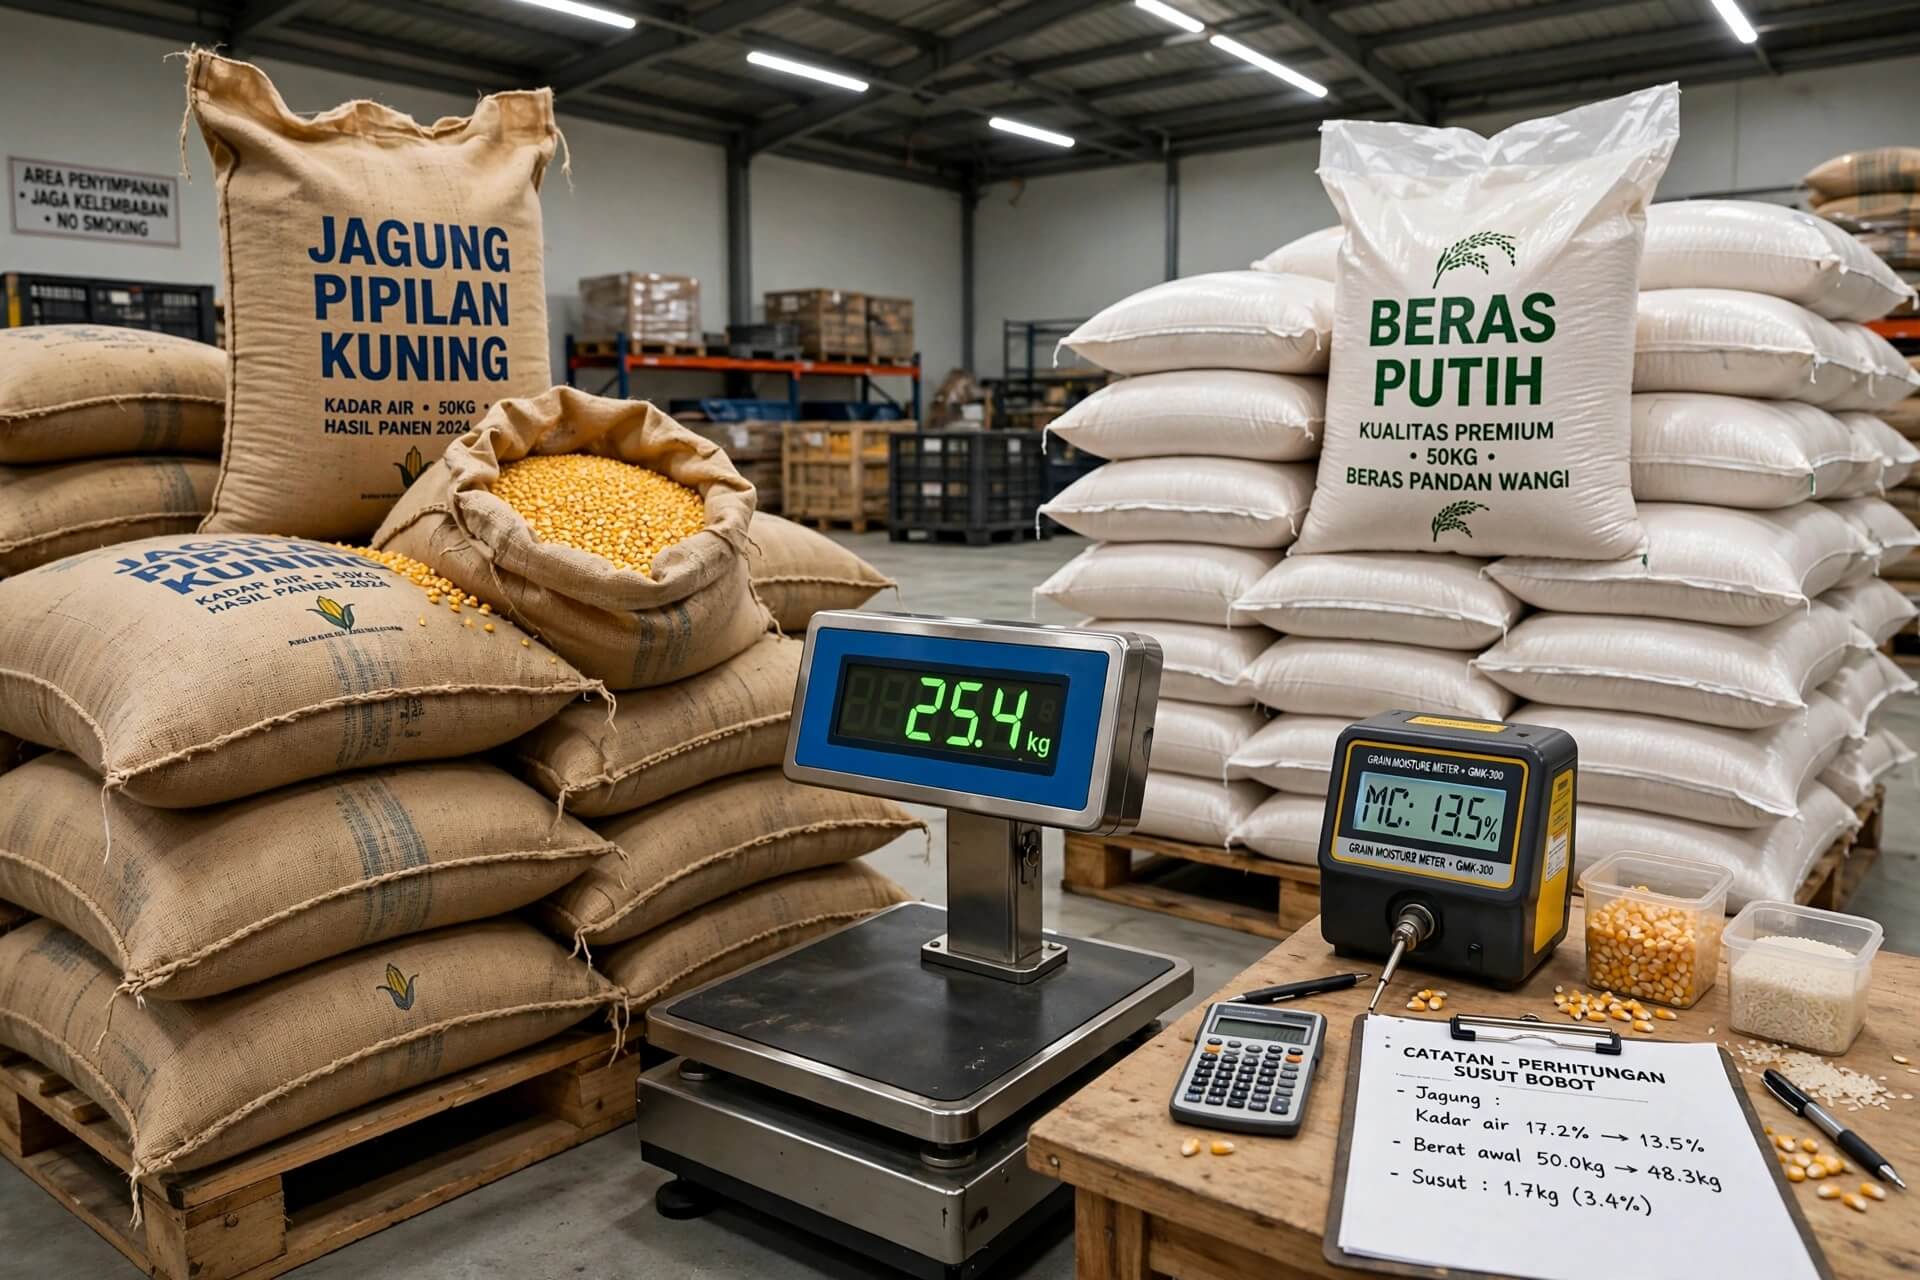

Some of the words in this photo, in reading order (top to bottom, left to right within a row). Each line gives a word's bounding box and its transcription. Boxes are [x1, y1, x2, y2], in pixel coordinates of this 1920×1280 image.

[24, 167, 65, 187] AREA
[69, 172, 170, 198] PENYIMPANAN
[31, 189, 70, 209] JAGA
[74, 193, 169, 218] KELEMBABAN
[57, 212, 79, 230] NO
[83, 215, 149, 237] SMOKING
[308, 215, 511, 273] JAGUNG
[314, 273, 510, 327] PIPILAN
[1369, 291, 1557, 347] BERAS
[321, 331, 509, 382] KUNING
[1374, 356, 1543, 408] PUTIH
[324, 397, 382, 416] KADAR
[387, 400, 414, 415] AIR
[438, 399, 476, 415] 50KG
[324, 419, 374, 436] HASIL
[378, 420, 432, 436] PANEN
[436, 419, 472, 435] 2024
[1359, 421, 1449, 441] KUALITAS
[1455, 421, 1554, 441] PREMIUM
[1426, 447, 1478, 466] 50KG
[1346, 466, 1404, 489] BERAS
[1409, 471, 1492, 491] PANDAN
[1499, 469, 1570, 491] WANGI
[195, 581, 269, 606] KADAR
[273, 574, 306, 586] AIR
[207, 592, 272, 614] HASIL
[272, 580, 342, 597] PANEN
[904, 676, 1029, 751] 25.4
[1026, 731, 1051, 759] kg
[1367, 754, 1391, 766] GRAIN
[1392, 757, 1431, 772] MOISTURE
[1431, 761, 1460, 775] METER
[1362, 785, 1415, 828] MC:
[1349, 842, 1373, 856] GRAIN
[1418, 853, 1446, 869] METER
[1403, 1046, 1494, 1067] CATATAN
[1518, 1057, 1666, 1084] PERHITUNGAN
[1453, 1065, 1519, 1084] SUSUT
[1525, 1073, 1596, 1091] BOBOT
[1415, 1085, 1481, 1109] Jagung
[1415, 1108, 1472, 1128] Kadar
[1482, 1119, 1510, 1132] air
[1525, 1120, 1590, 1140] 17.2%
[1640, 1133, 1706, 1154] 13.5%
[1413, 1136, 1466, 1157] Berat
[1477, 1148, 1522, 1163] awal
[1536, 1151, 1606, 1178] 50.0kg
[1647, 1165, 1723, 1193] 48.3kg
[1411, 1168, 1468, 1191] Susut
[1504, 1180, 1560, 1208] 1.7kg
[1571, 1186, 1653, 1217] (3.4%)
